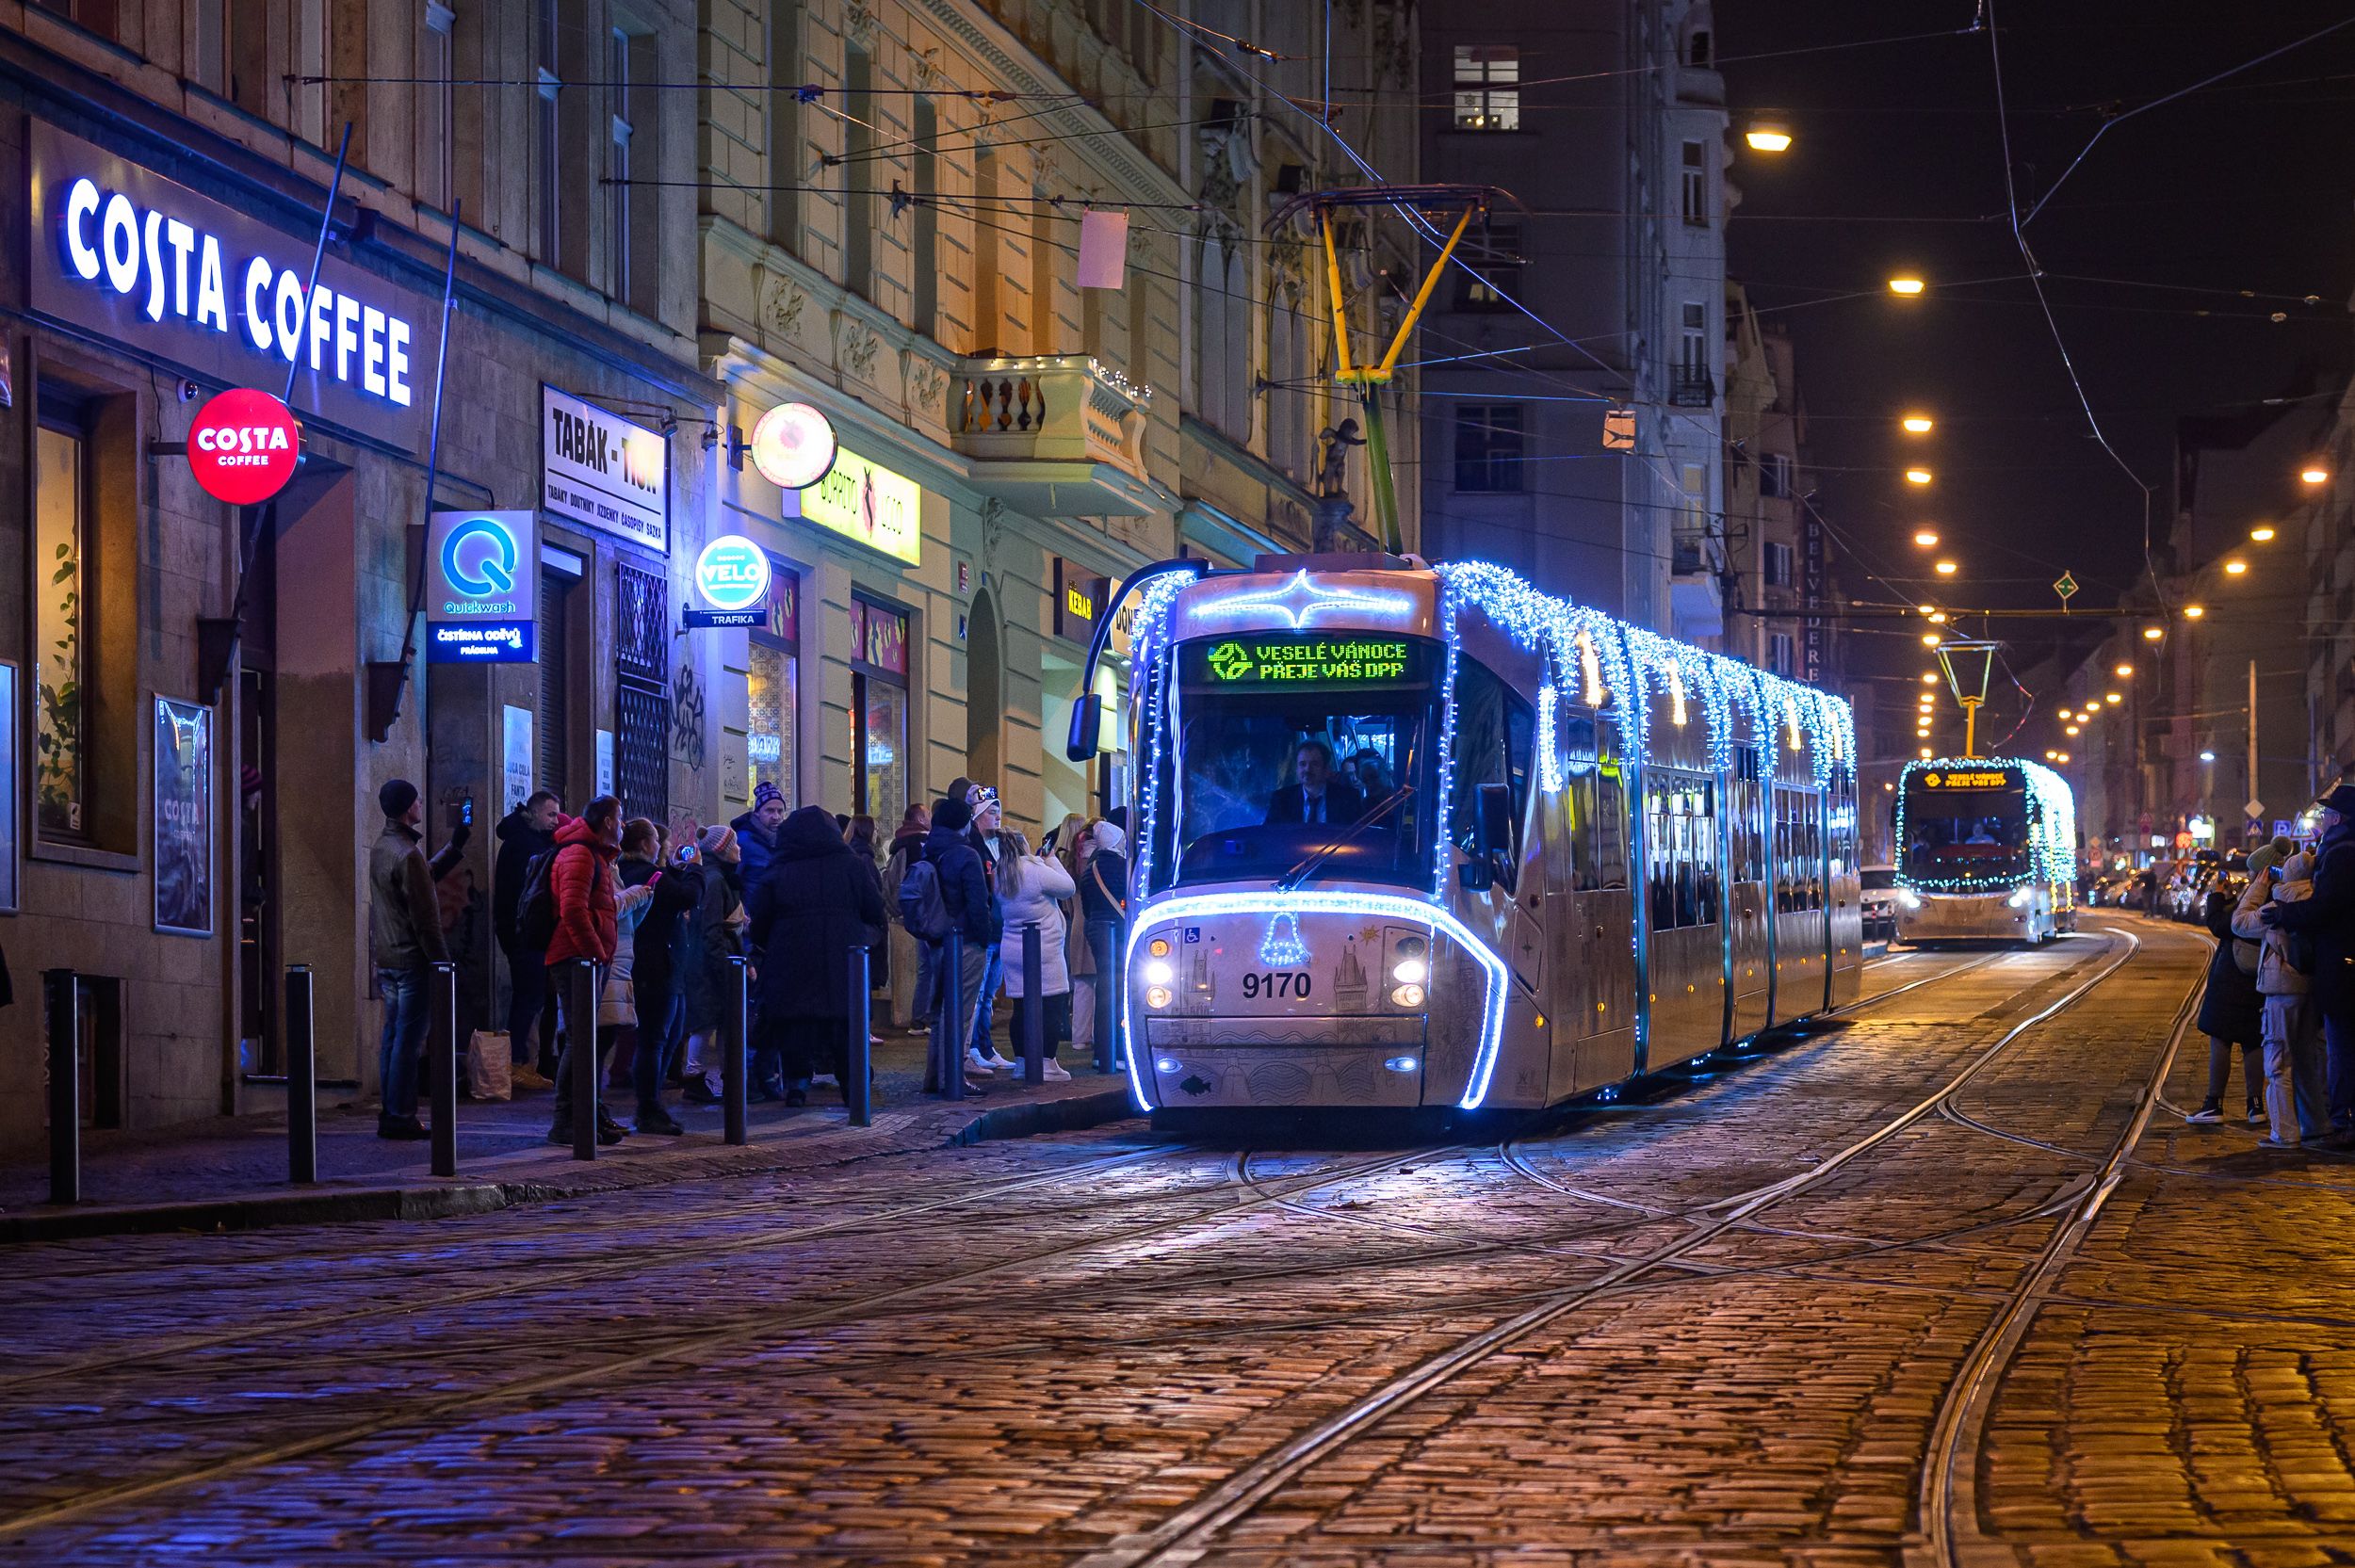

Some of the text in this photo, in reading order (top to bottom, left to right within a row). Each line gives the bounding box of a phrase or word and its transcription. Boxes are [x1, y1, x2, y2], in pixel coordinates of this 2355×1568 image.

[67, 177, 412, 408] COSTA COFFEE
[197, 427, 289, 454] COSTA
[553, 408, 609, 476] TABÁK
[218, 455, 269, 466] COFFEE
[820, 469, 858, 515] BURRITO
[646, 523, 662, 540] SAZKA
[701, 563, 762, 582] VELO
[444, 601, 516, 614] Quickwash
[1068, 589, 1093, 622] KEBAB
[1807, 523, 1821, 683] BELVEDERE
[712, 615, 755, 624] TRAFIKA
[1256, 641, 1408, 661] VESELÉ VÁNOCE
[1259, 660, 1405, 680] PŘEJE VÁŠ DPP
[519, 763, 530, 777] COLA
[511, 784, 526, 799] FANTA
[164, 799, 200, 826] COSTA
[1242, 972, 1312, 999] 9170
